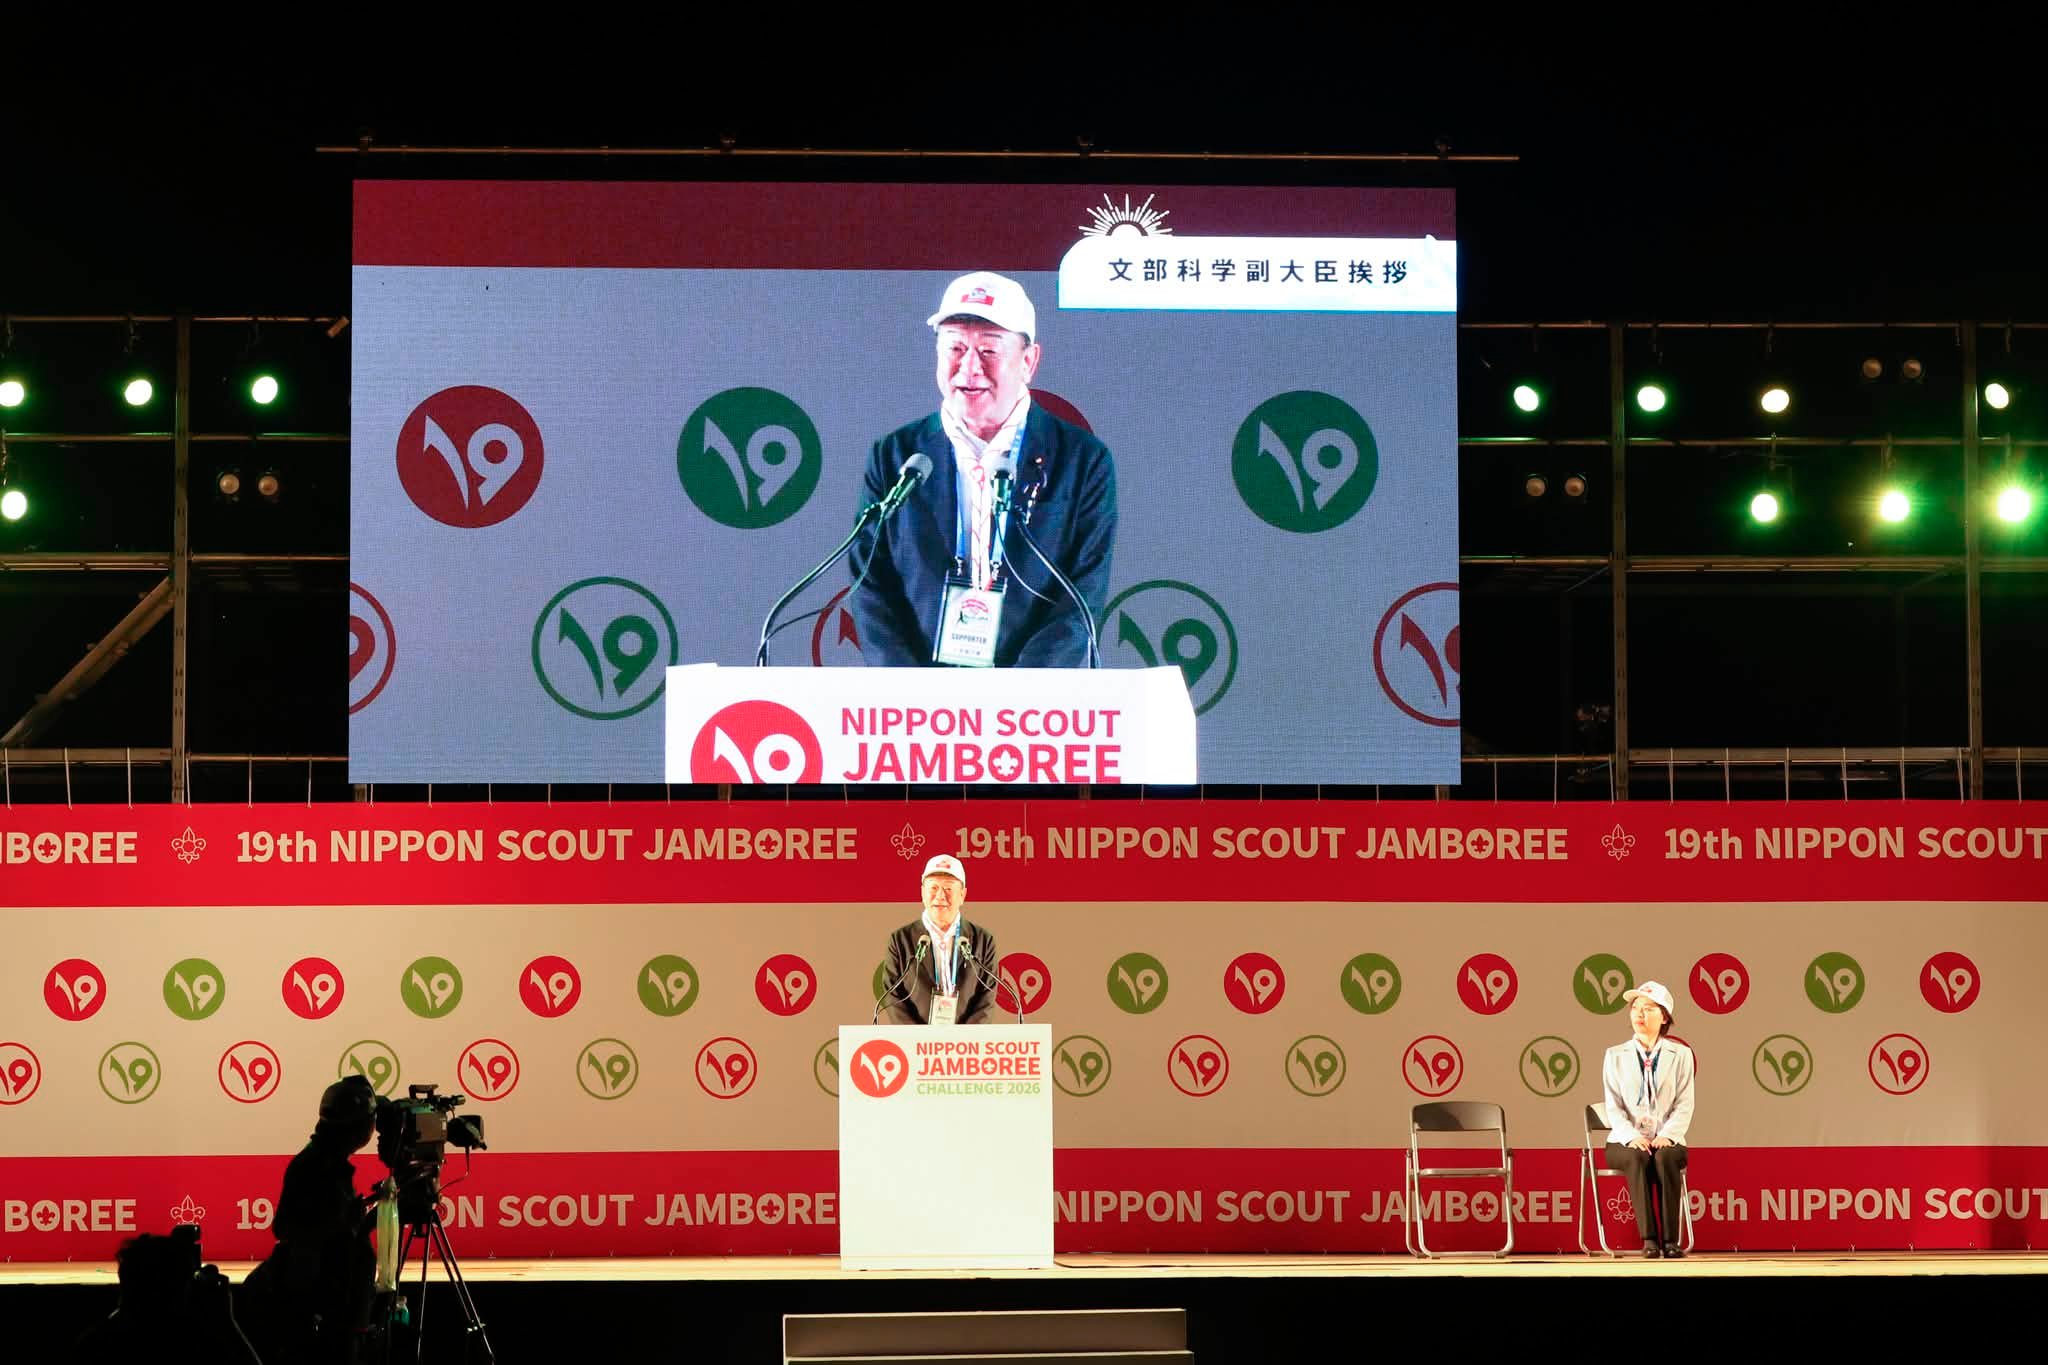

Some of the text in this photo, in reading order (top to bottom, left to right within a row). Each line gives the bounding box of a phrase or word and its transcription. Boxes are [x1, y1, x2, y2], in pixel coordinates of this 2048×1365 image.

[1108, 257, 1408, 284] 文部科学副大臣挨拶
[423, 414, 524, 511] 19
[703, 417, 803, 512] 19
[1258, 419, 1359, 513] 19
[559, 606, 659, 700] 19
[842, 707, 1121, 738] NIPPON SCOUT
[843, 742, 1121, 784] JAMBOREE
[0, 831, 138, 864] BOREE
[237, 827, 858, 863] 19th NIPPON SCOUT JAMBOREE
[955, 826, 1569, 860] 19th NIPPON SCOUT JAMBOREE
[1664, 826, 2048, 860] 19th NIPPON SCOUT
[54, 971, 98, 1013] 19
[173, 971, 217, 1012] 19
[292, 970, 336, 1011] 19
[411, 969, 454, 1010] 19
[529, 968, 573, 1009] 19
[648, 968, 691, 1008] 19
[765, 967, 809, 1008] 19
[1118, 966, 1161, 1006] 19
[1234, 966, 1277, 1007] 19
[1351, 967, 1394, 1007] 19
[1467, 967, 1510, 1007] 19
[1583, 967, 1626, 1007] 19
[1699, 966, 1742, 1007] 19
[1815, 966, 1857, 1006] 19
[1930, 965, 1972, 1005] 19
[916, 1041, 1041, 1055] NIPPON SCOUT
[917, 1057, 1041, 1076] JAMBOREE
[1060, 1048, 1103, 1088] 19
[1178, 1048, 1221, 1088] 19
[1295, 1048, 1338, 1088] 19
[1413, 1048, 1456, 1088] 19
[1762, 1047, 1805, 1087] 19
[1879, 1046, 1922, 1087] 19
[109, 1055, 153, 1095] 19
[229, 1054, 273, 1095] 19
[468, 1052, 512, 1093] 19
[587, 1051, 631, 1092] 19
[706, 1051, 750, 1091] 19
[860, 1051, 902, 1091] 19
[917, 1081, 1041, 1095] CHALLENGE 2026
[1529, 1048, 1573, 1089] 19
[498, 1194, 634, 1227] SCOUT
[644, 1192, 836, 1226] JAMBORE
[1053, 1190, 1573, 1223] NIPPON SCOUT JAMBOREE
[1760, 1188, 1911, 1220] NIPPON
[1924, 1187, 2048, 1220] SCOUT
